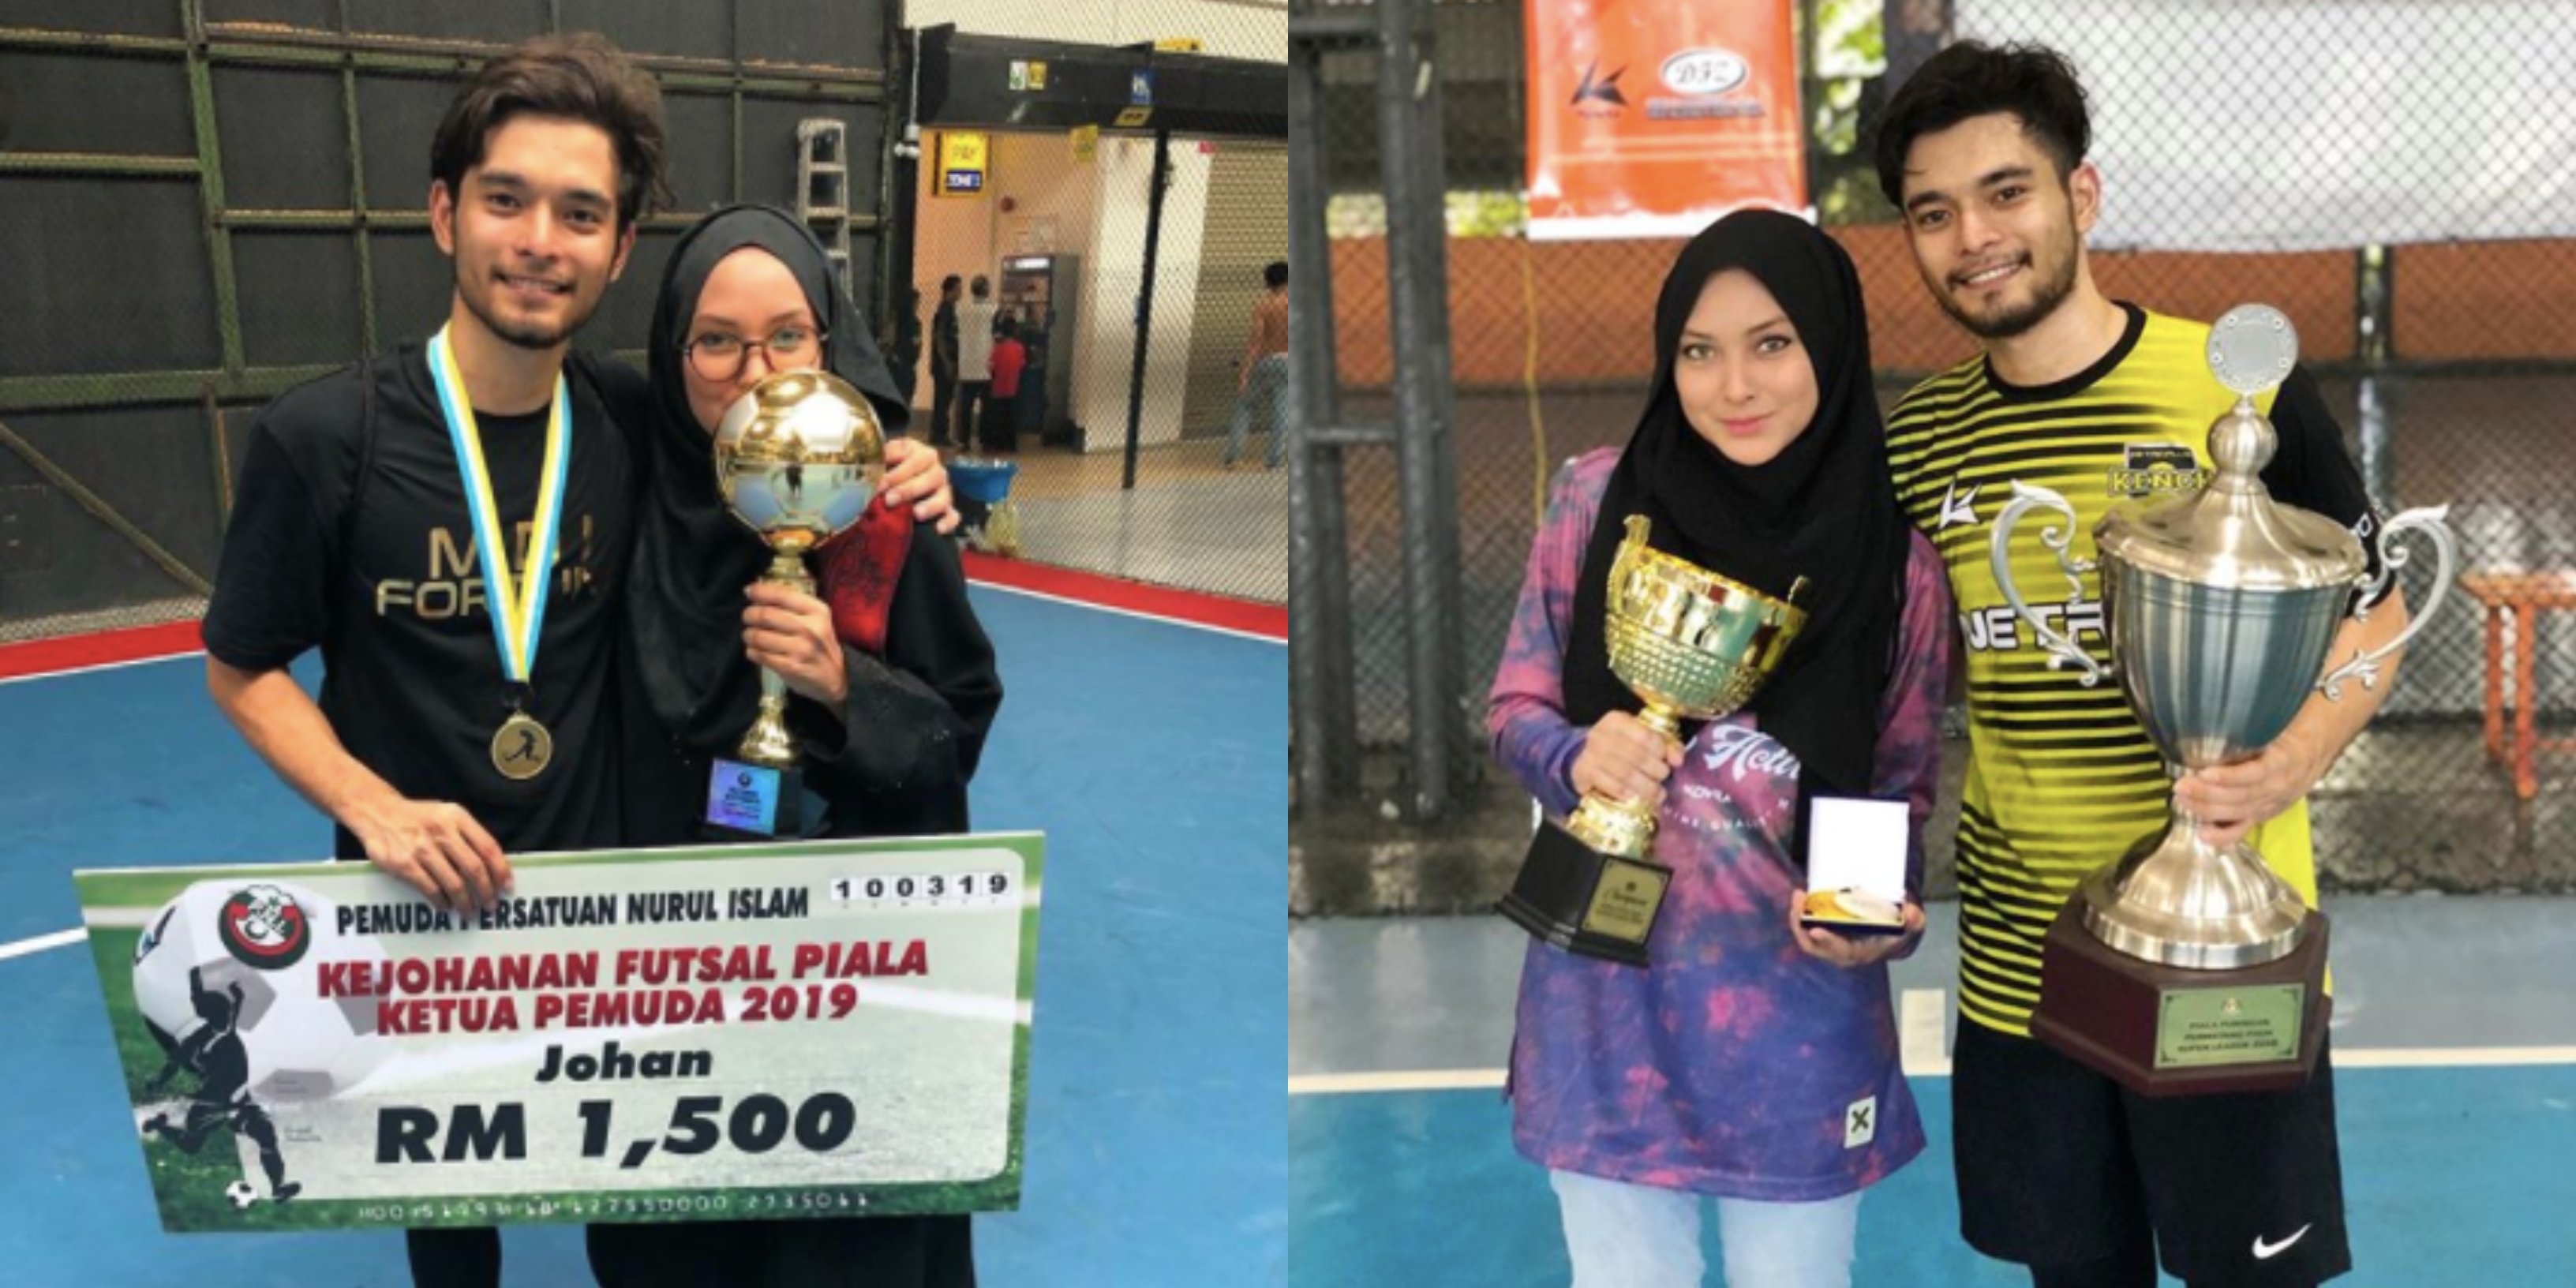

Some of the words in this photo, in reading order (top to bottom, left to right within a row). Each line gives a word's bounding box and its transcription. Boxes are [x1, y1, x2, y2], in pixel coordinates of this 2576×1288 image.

[337, 900, 451, 936] PEMUDA
[460, 893, 617, 930] ERSATUAN
[627, 889, 719, 924] NURUL
[728, 886, 809, 919] ISLAM
[317, 951, 599, 998] KEJOHANAN
[615, 944, 777, 987] FUTSAL
[792, 938, 928, 979] PIALA
[376, 995, 519, 1036] KETUA
[533, 987, 725, 1030] PEMUDA
[740, 983, 857, 1021] 2019
[535, 1042, 713, 1082] Johan
[375, 1102, 527, 1164] RM
[578, 1091, 857, 1169] 1,500
